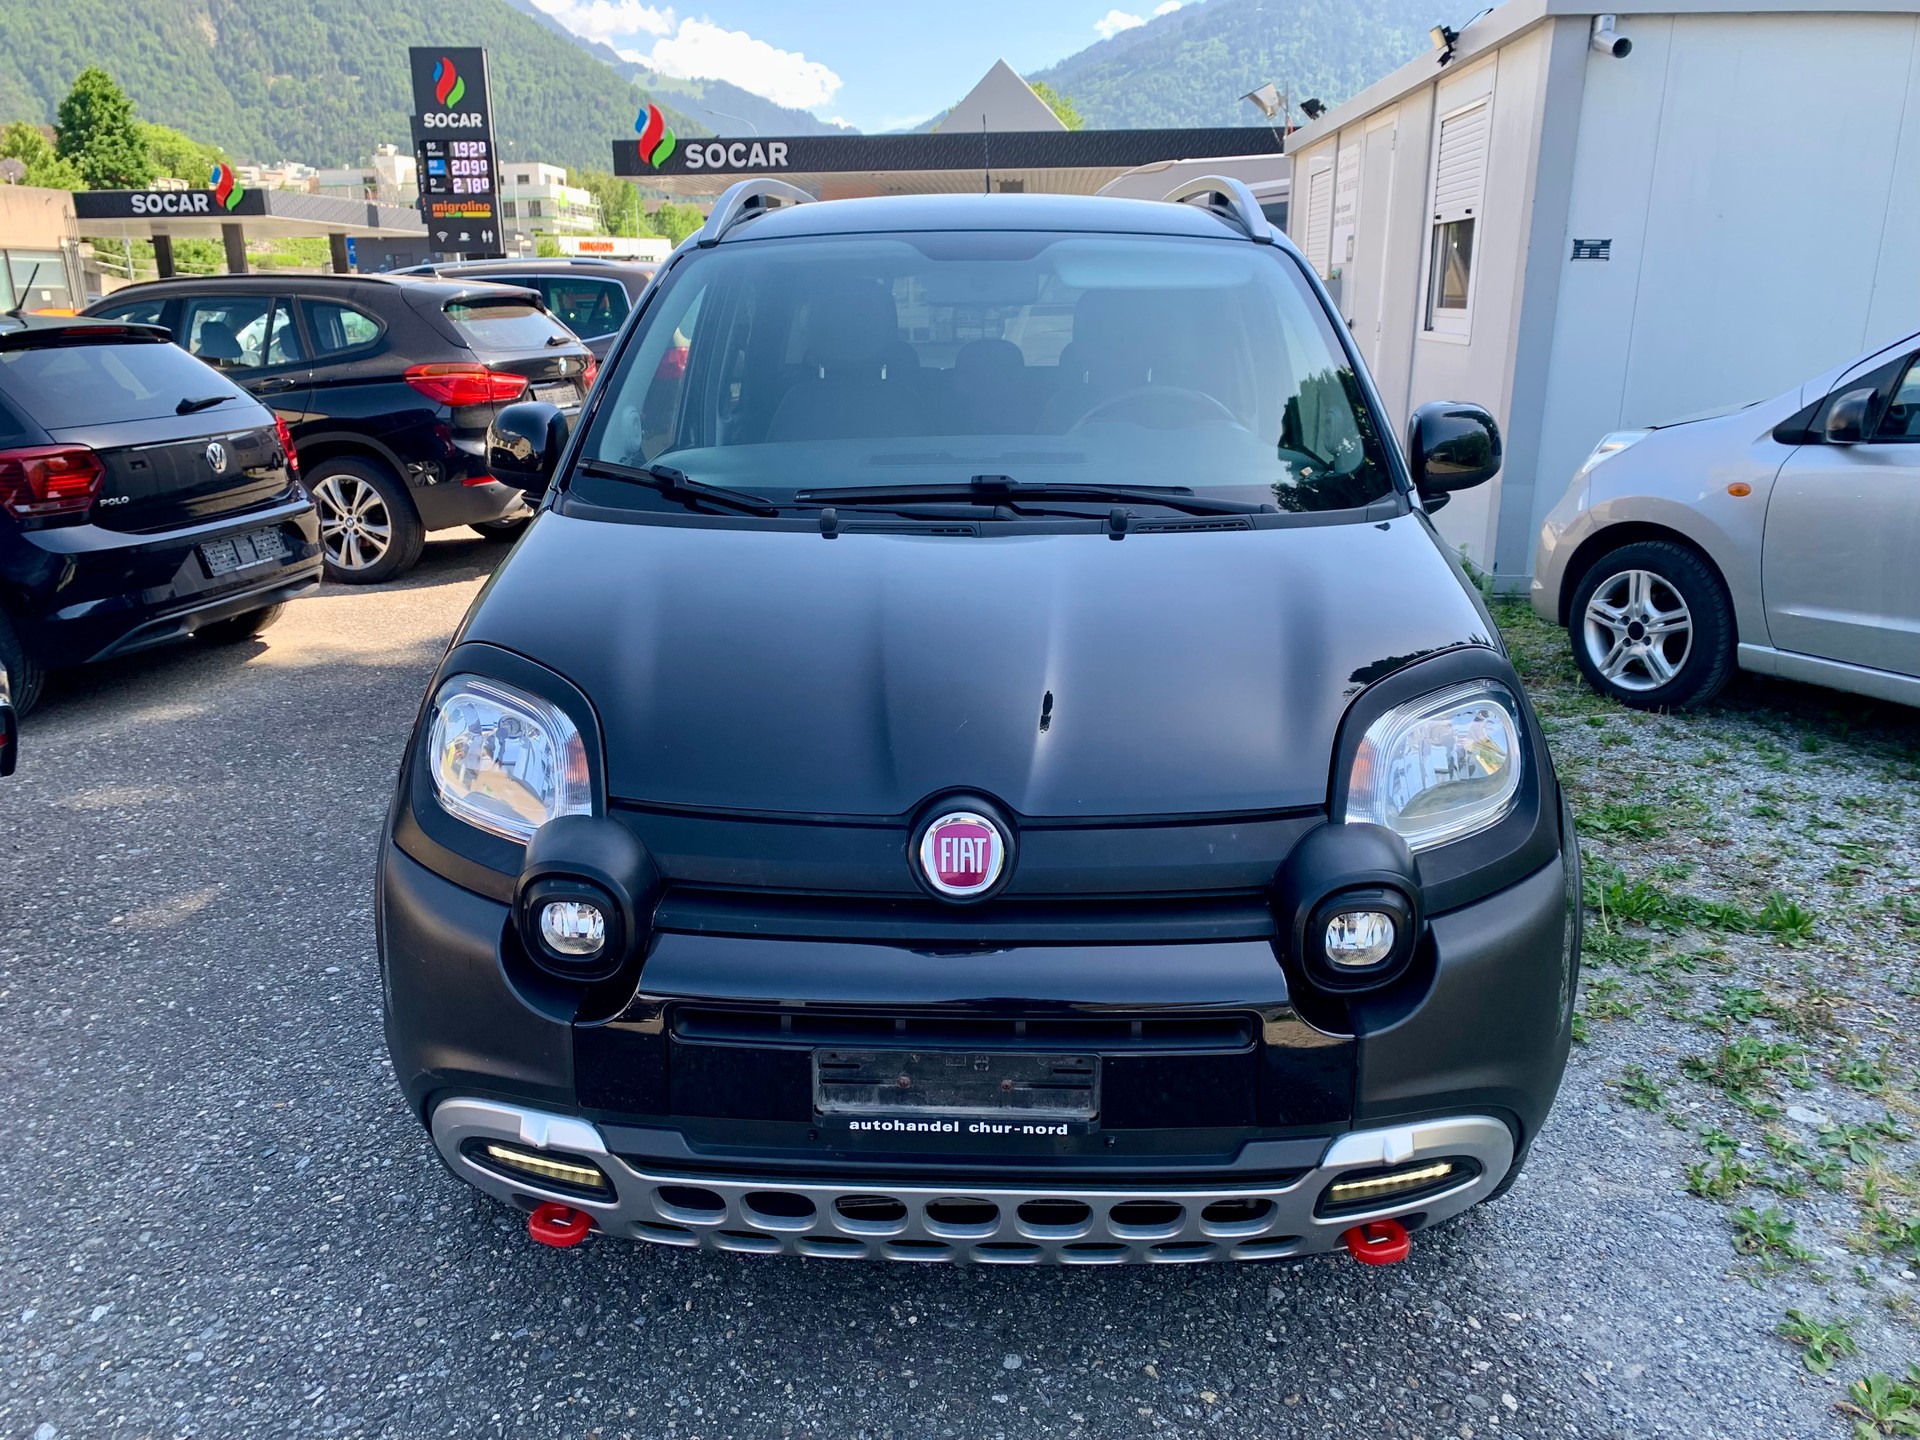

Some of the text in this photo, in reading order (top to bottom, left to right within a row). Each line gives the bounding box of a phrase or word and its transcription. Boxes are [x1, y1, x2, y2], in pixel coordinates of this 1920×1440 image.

[424, 113, 482, 128] SOCAR
[684, 142, 789, 169] SOCAR
[131, 193, 210, 214] SOCAR
[432, 201, 490, 213] migrolino
[99, 495, 130, 507] POLO
[941, 837, 987, 873] FIAT
[849, 1119, 1068, 1136] autohandel chur-nord
